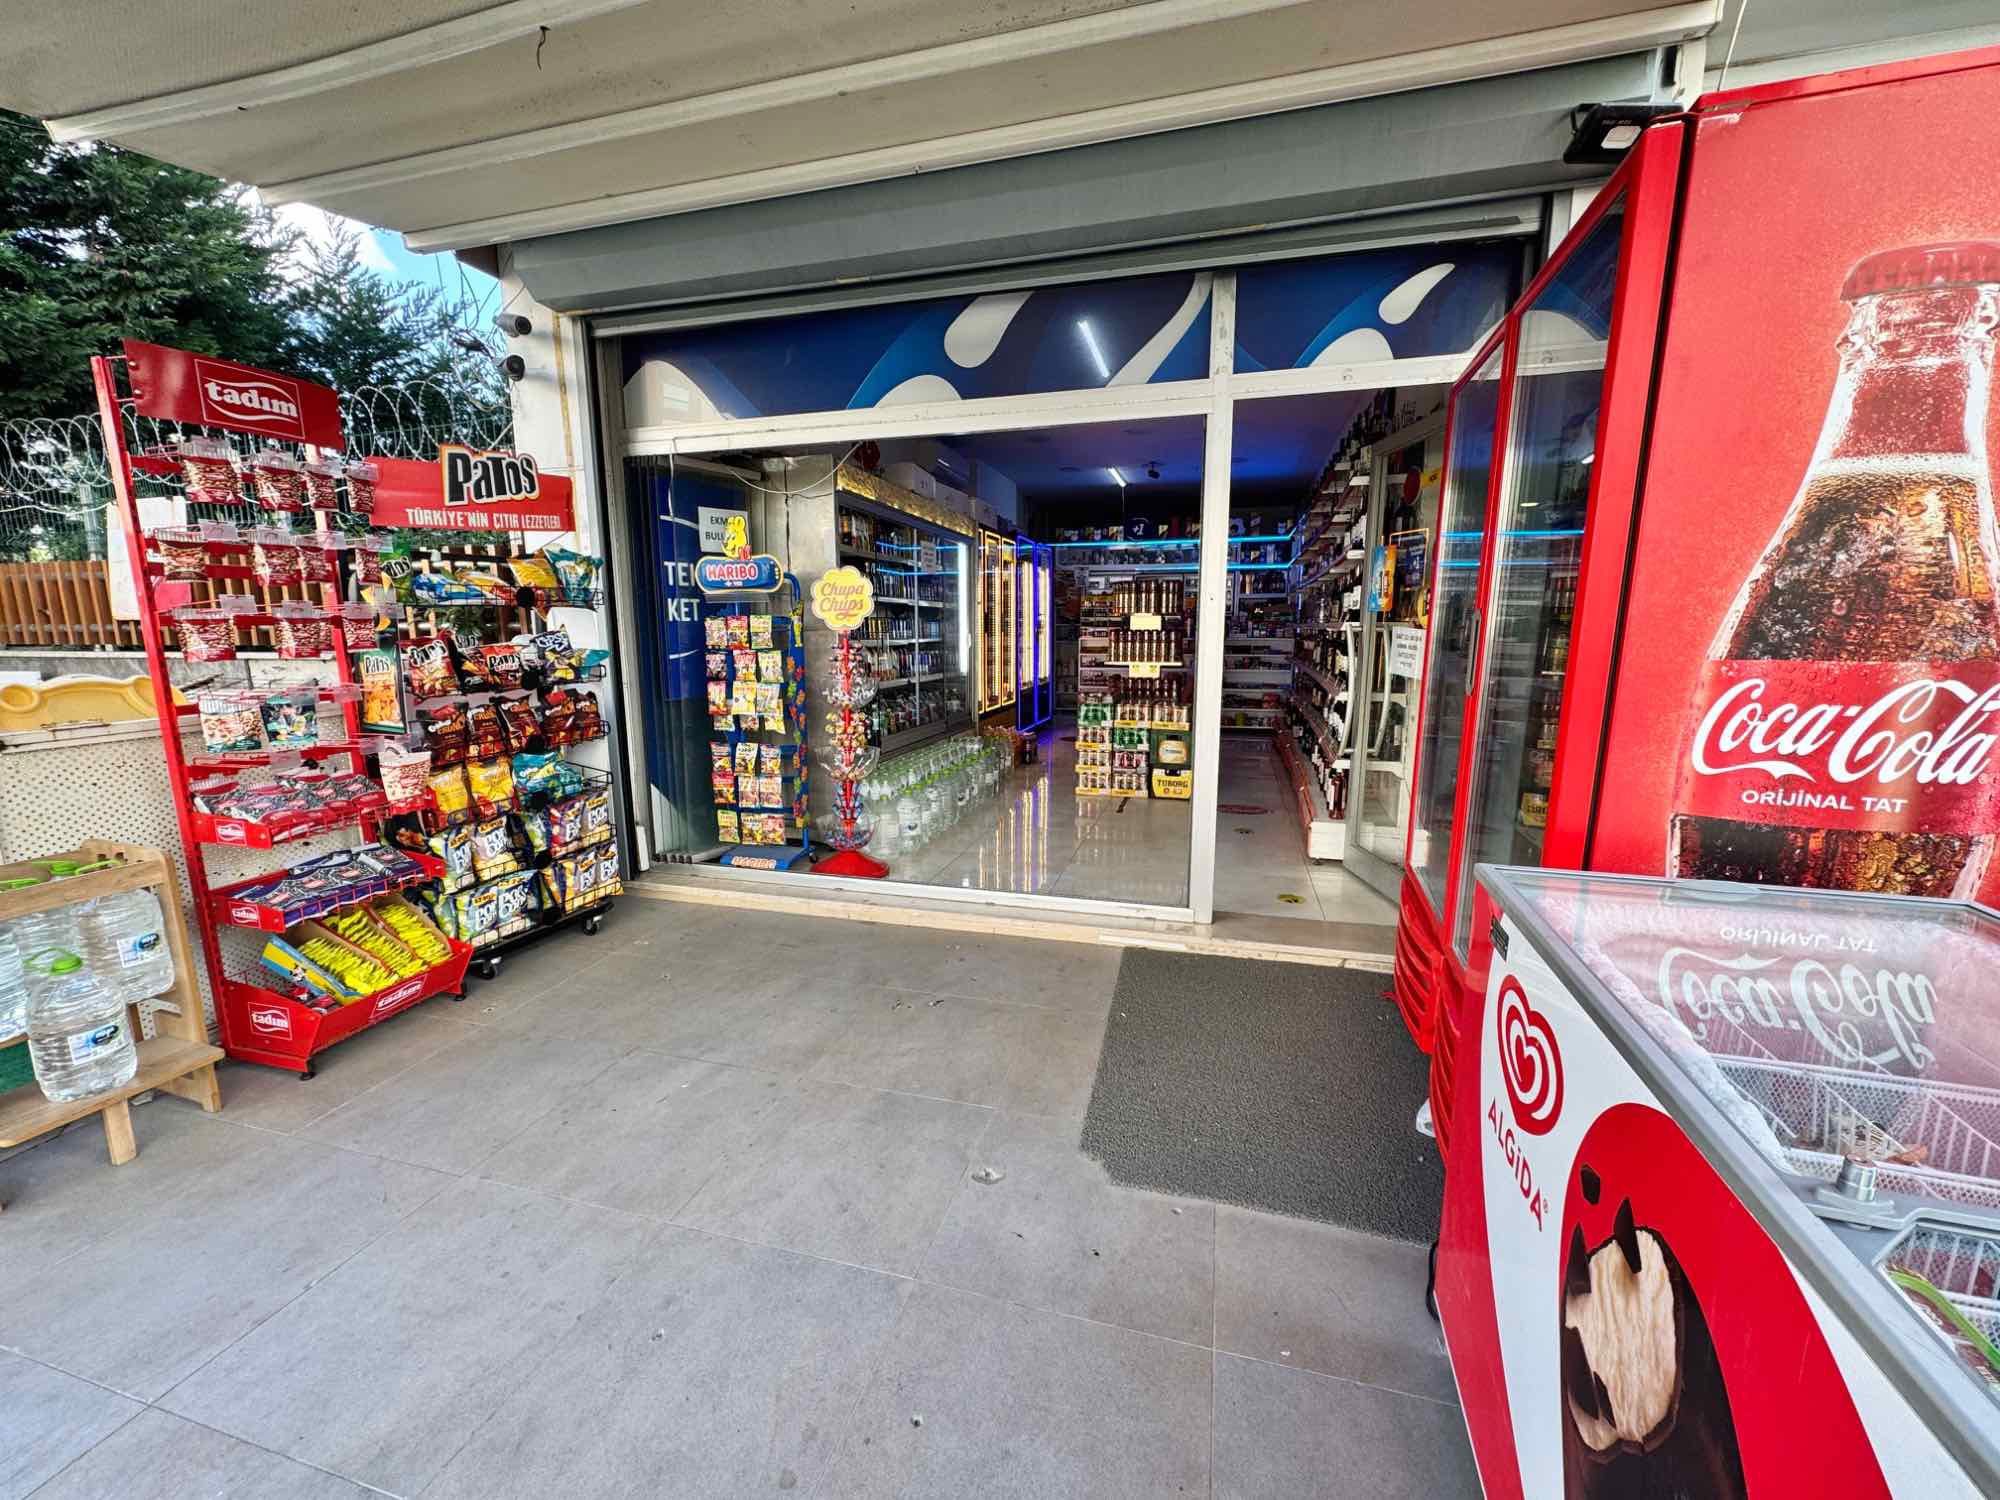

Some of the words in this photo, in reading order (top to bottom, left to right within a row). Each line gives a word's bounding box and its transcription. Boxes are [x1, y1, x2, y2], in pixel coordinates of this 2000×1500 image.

[204, 381, 298, 418] tadım
[405, 506, 489, 528] TÜRKİYE'NİN
[706, 563, 758, 581] HARIBO
[820, 582, 865, 600] Chupa
[820, 597, 865, 620] Chups
[1691, 678, 2000, 785] Coca-Cola
[1156, 779, 1189, 788] TUBORG
[1741, 788, 1854, 811] ORİJİNAL
[1861, 797, 1908, 813] TAT
